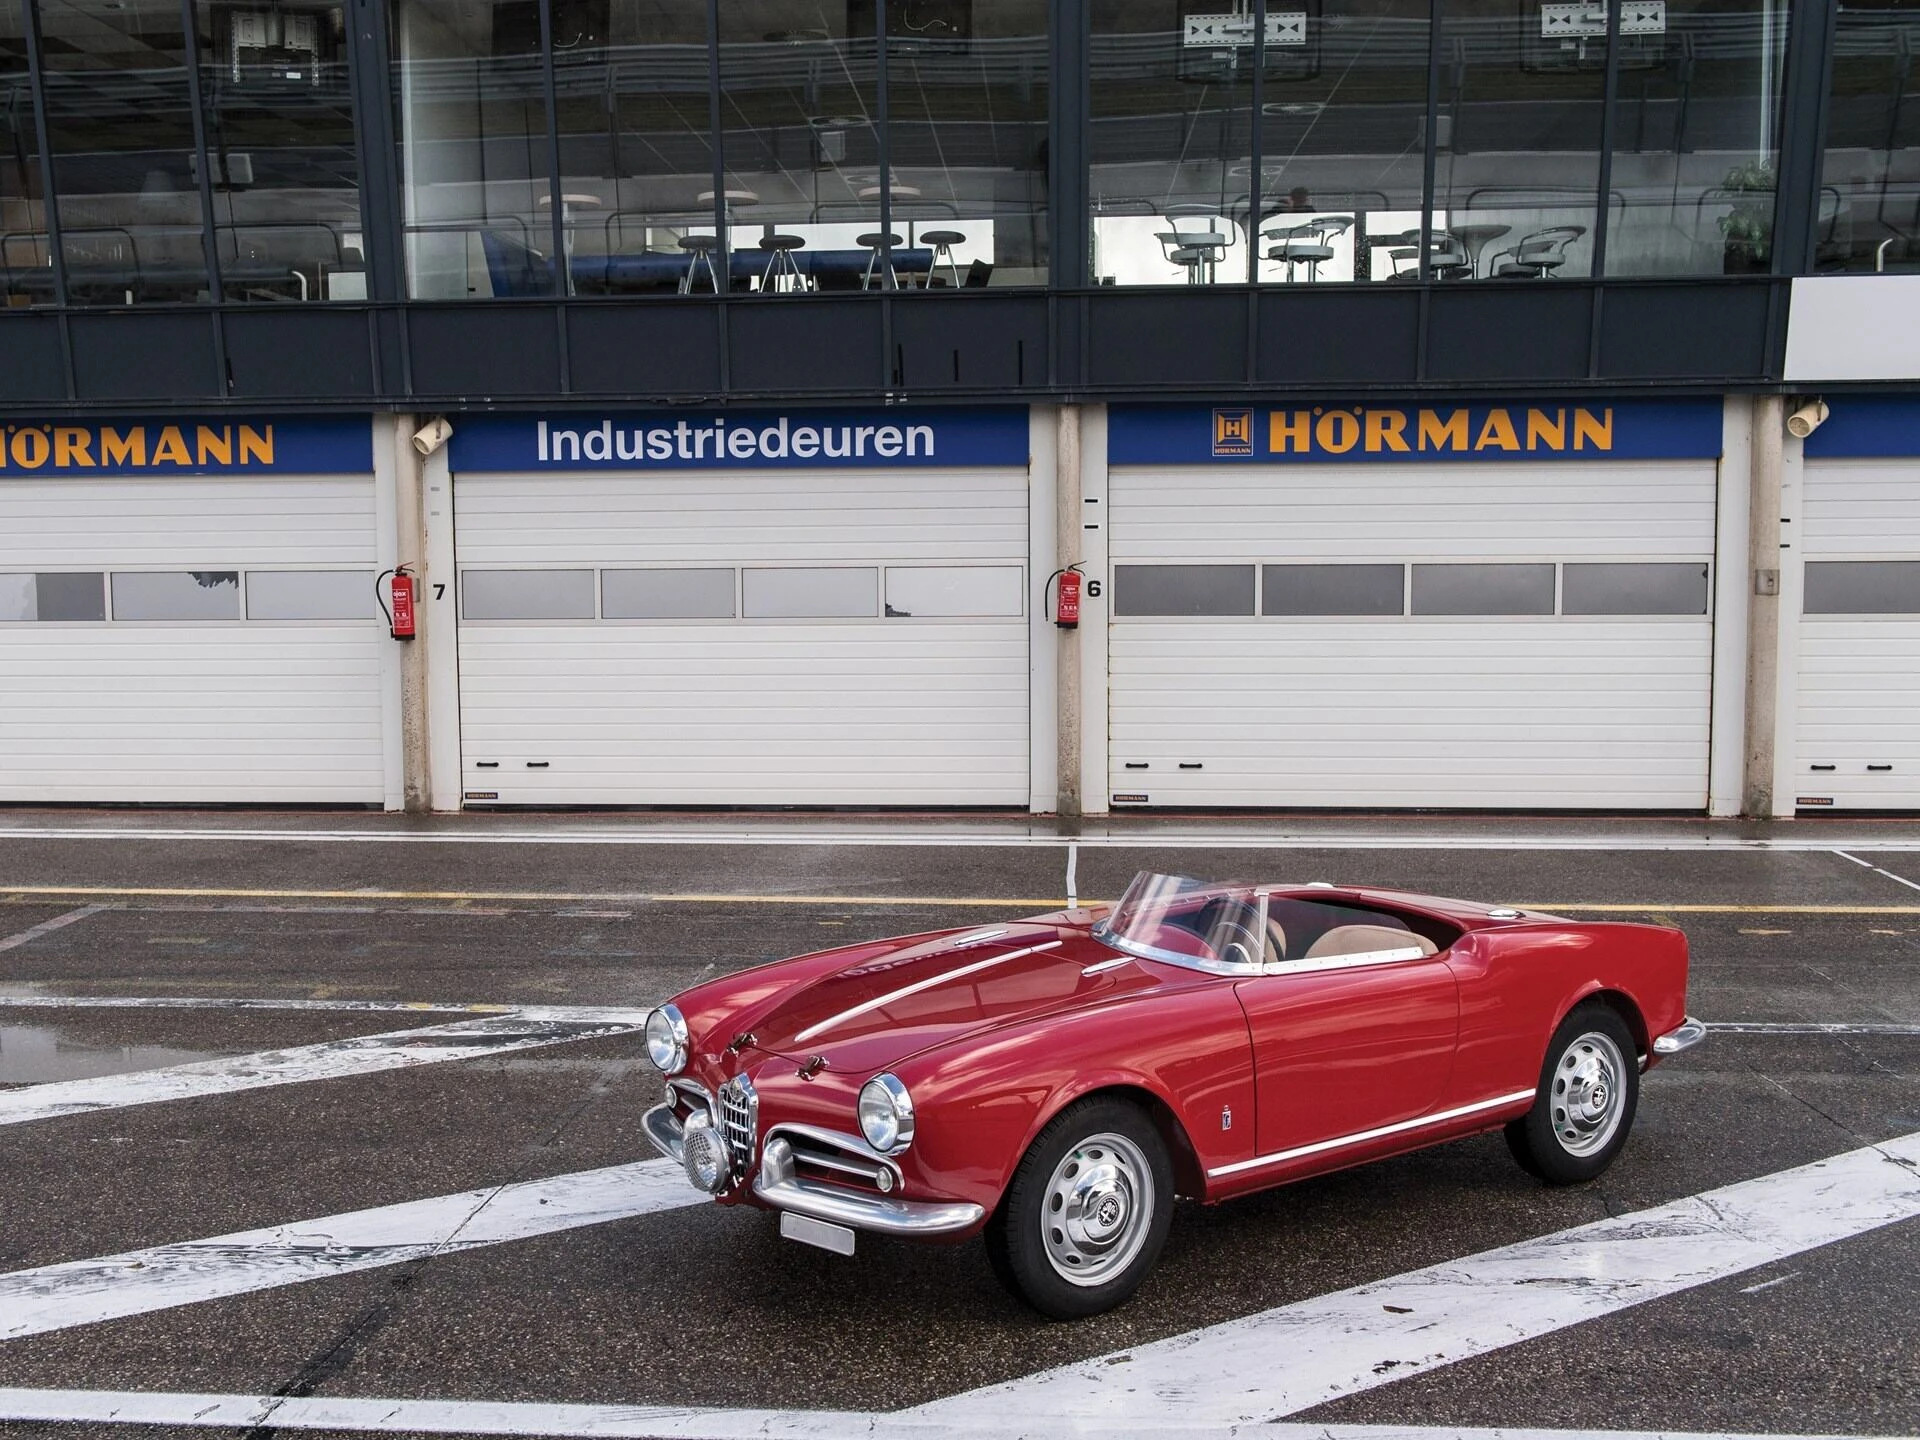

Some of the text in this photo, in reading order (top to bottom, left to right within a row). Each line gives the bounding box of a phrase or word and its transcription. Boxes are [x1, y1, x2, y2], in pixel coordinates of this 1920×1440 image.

[537, 417, 934, 461] Industriedeuren
[1269, 406, 1613, 454] HÖRMANN
[433, 583, 445, 601] 7
[1087, 580, 1101, 597] 6
